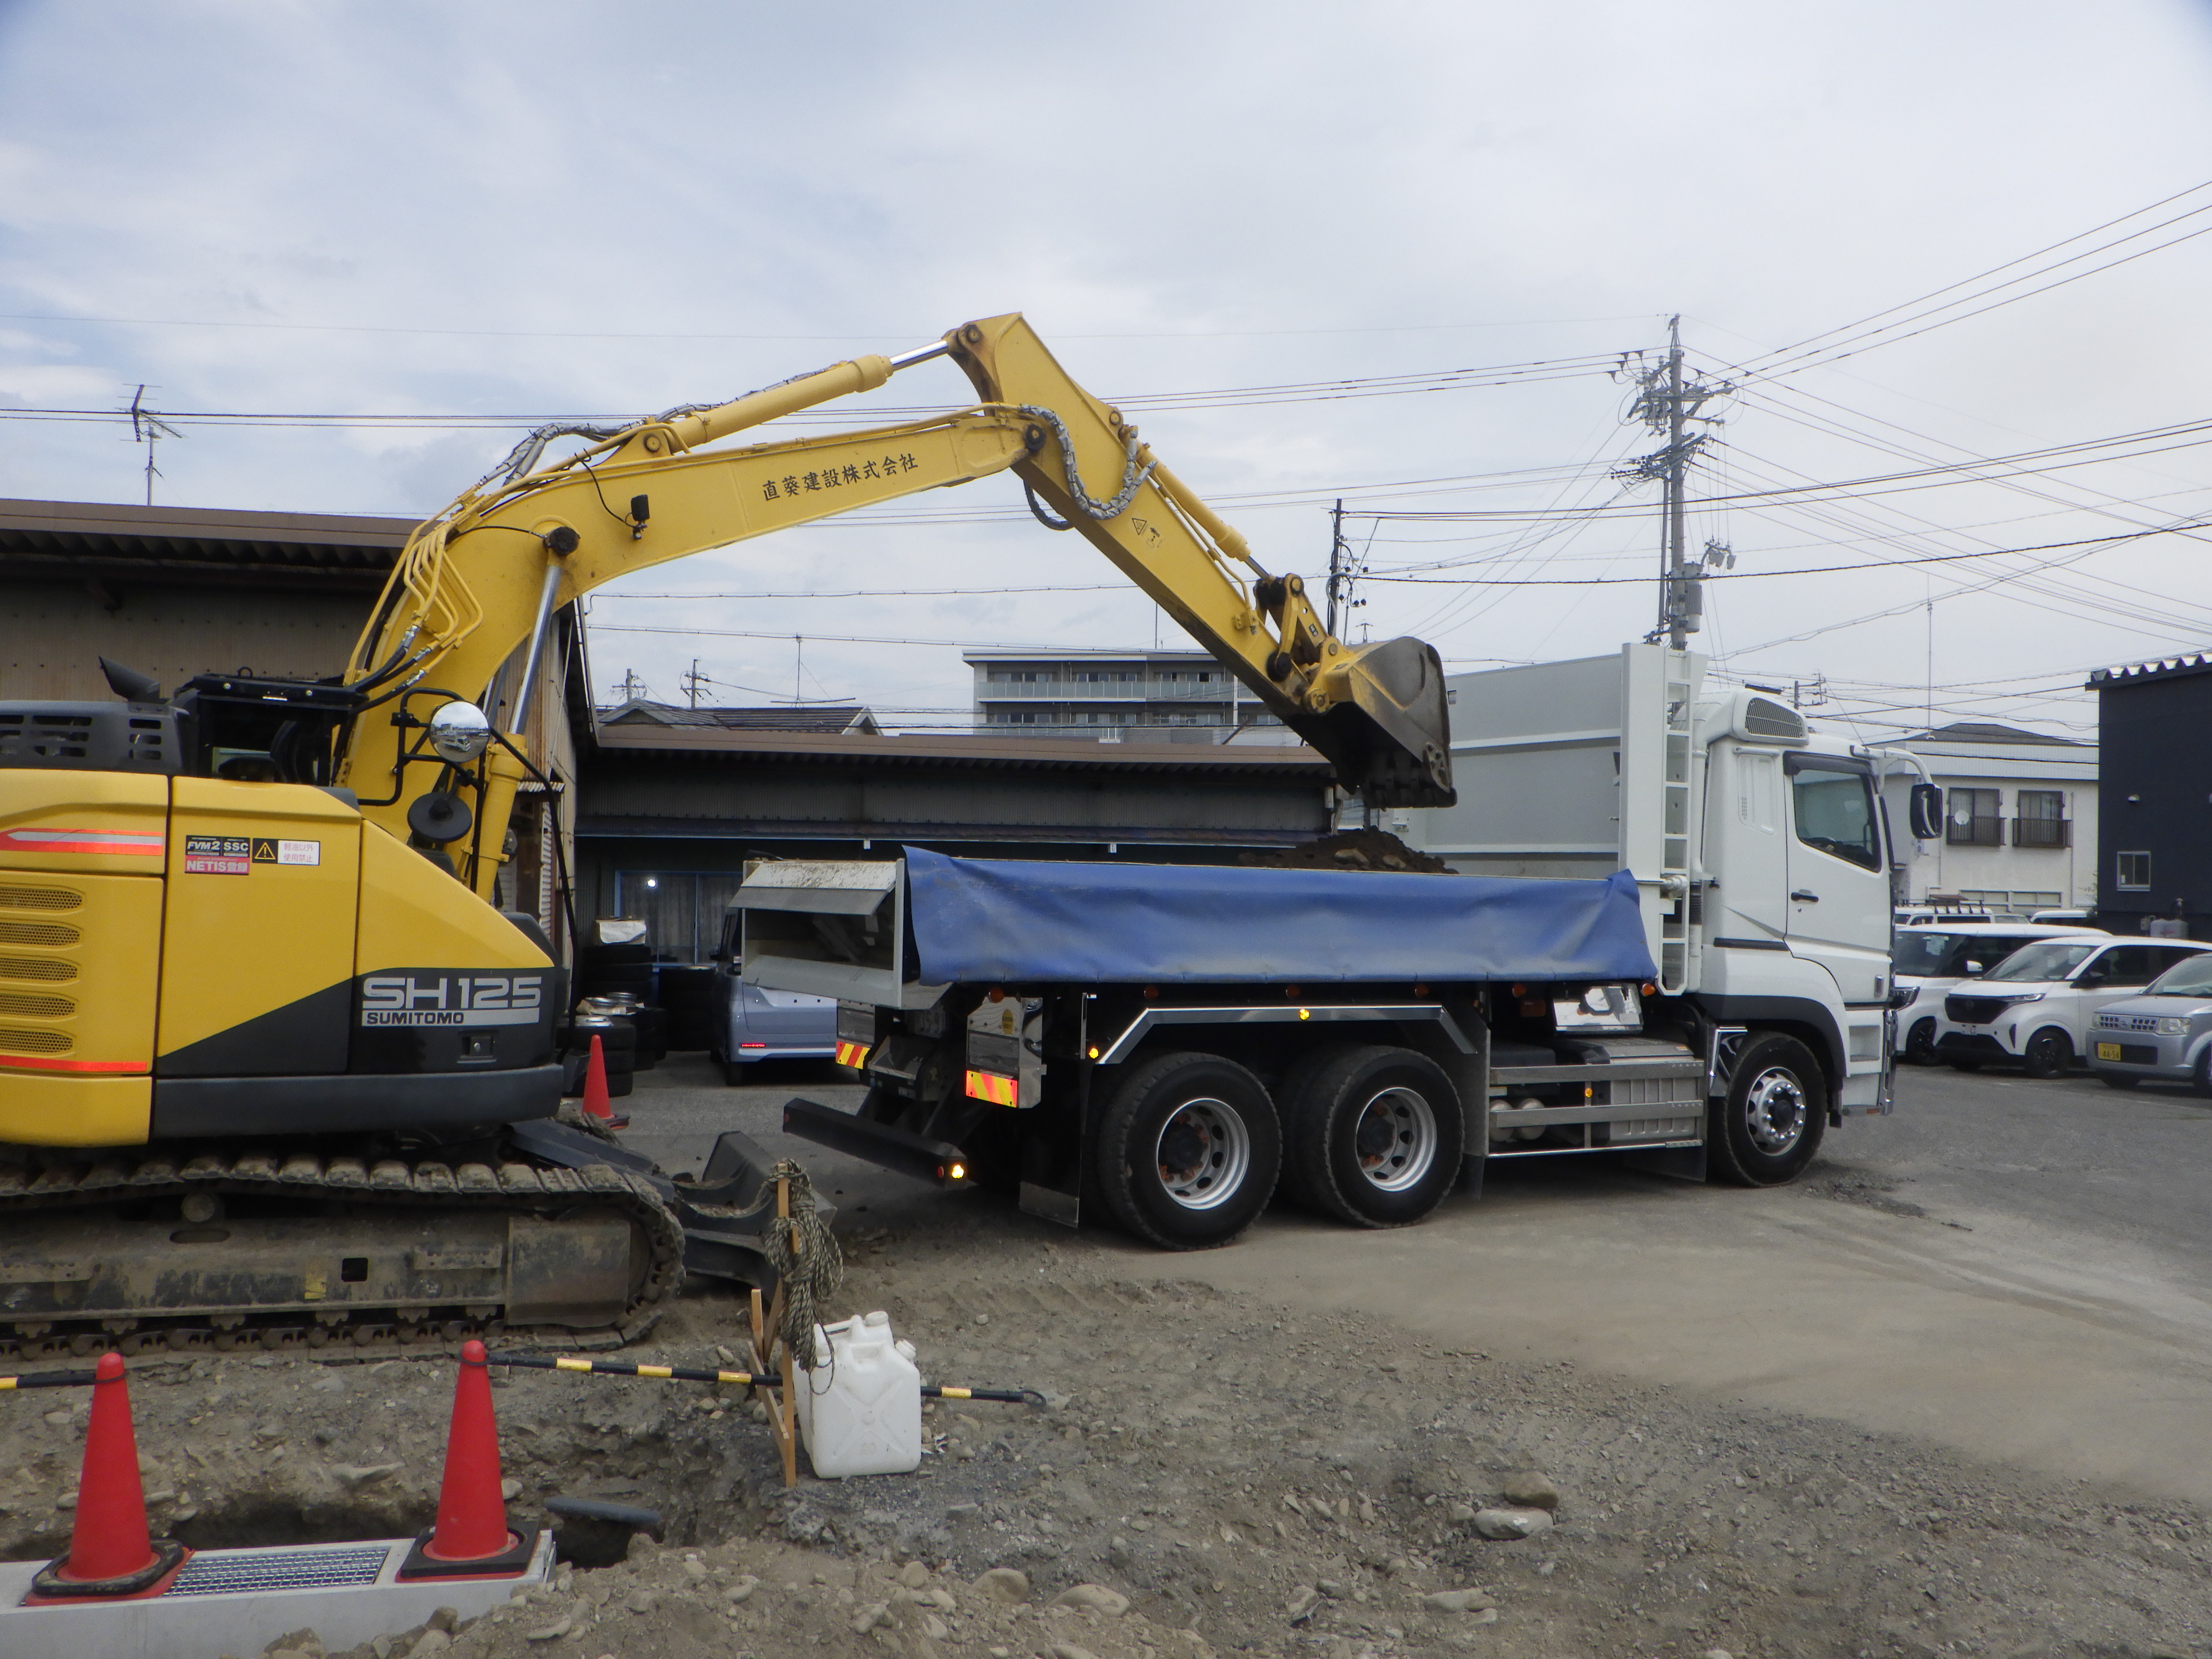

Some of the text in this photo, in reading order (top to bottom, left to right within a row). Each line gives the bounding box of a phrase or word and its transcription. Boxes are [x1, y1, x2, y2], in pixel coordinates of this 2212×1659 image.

[762, 453, 918, 501] 直葵建設株式会社
[187, 841, 221, 851] FVM2
[223, 841, 249, 852] SSC
[284, 853, 313, 863] 使用禁止
[367, 1012, 464, 1025] SUMITOMO
